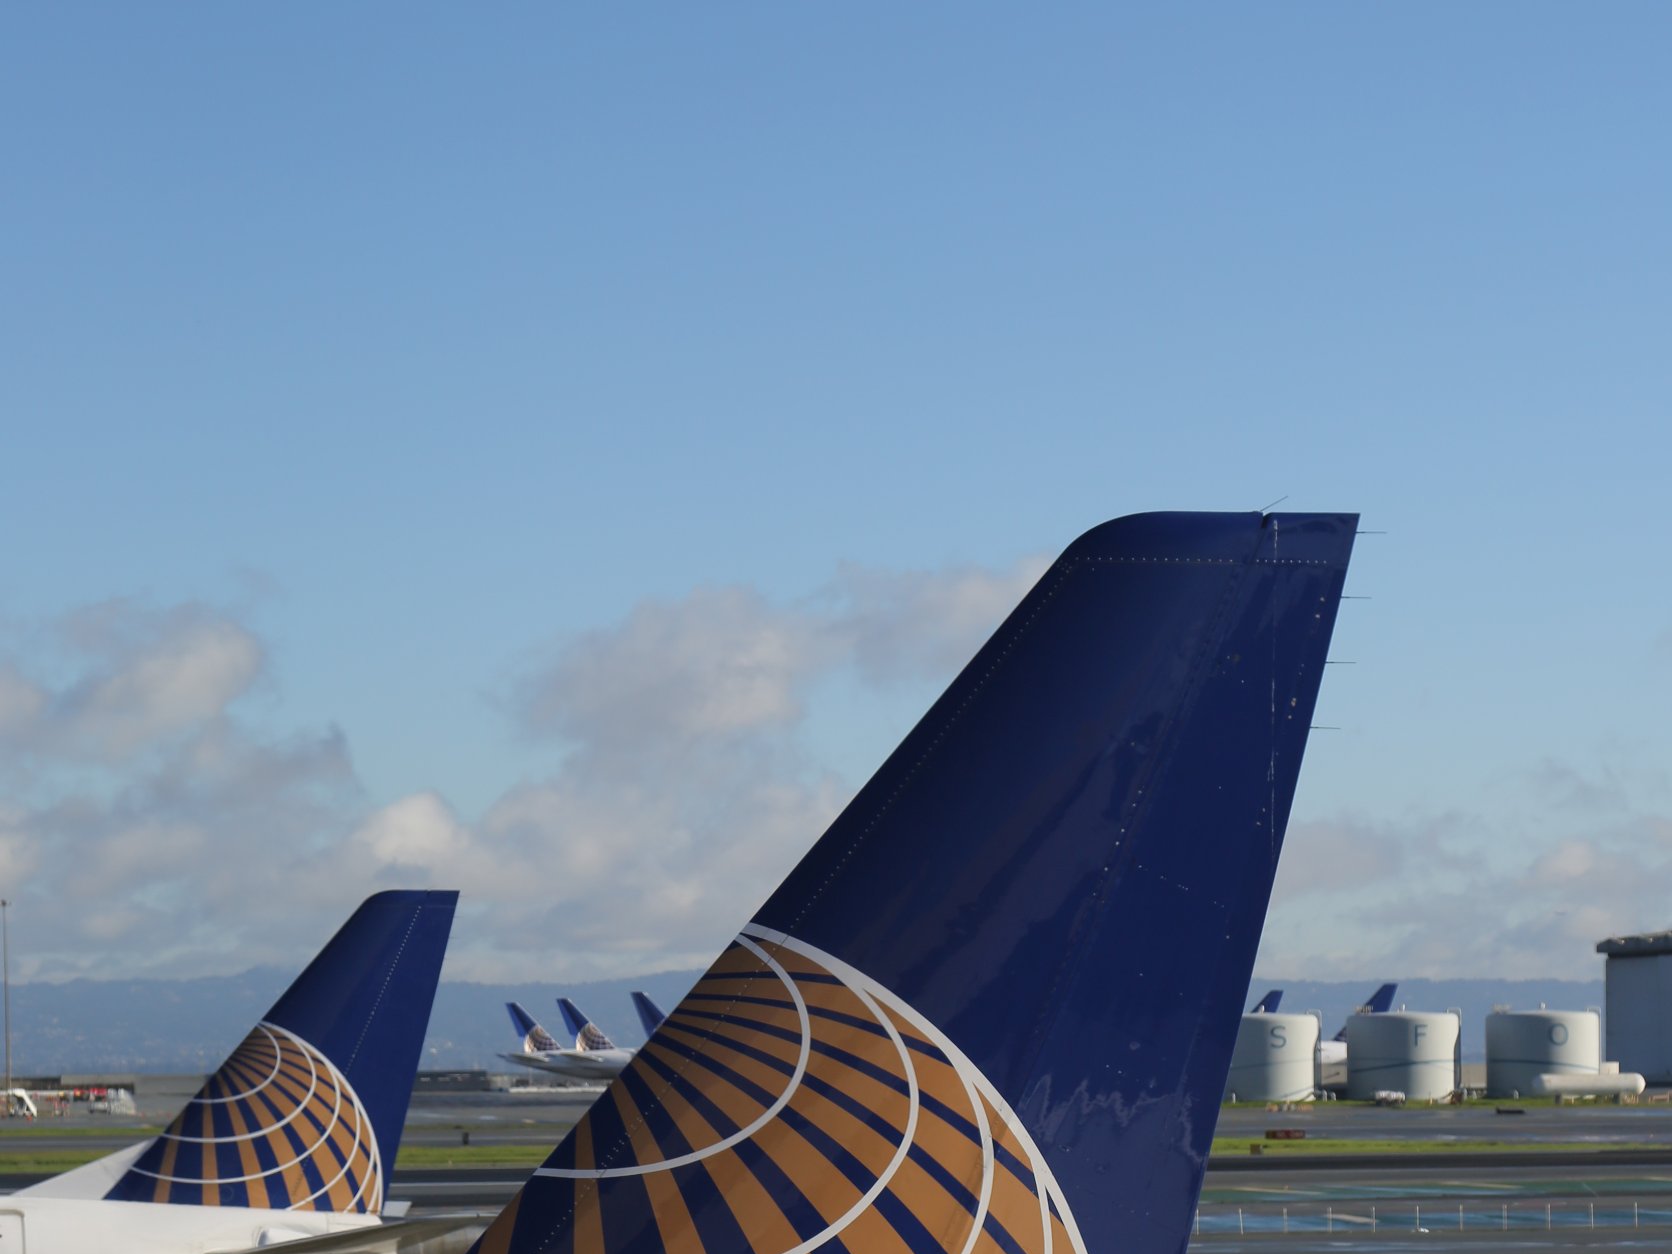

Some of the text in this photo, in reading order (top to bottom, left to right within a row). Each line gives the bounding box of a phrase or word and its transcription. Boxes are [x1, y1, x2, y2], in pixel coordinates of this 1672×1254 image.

[1270, 1025, 1287, 1049] S
[1414, 1023, 1428, 1047] F
[1548, 1023, 1569, 1046] O
